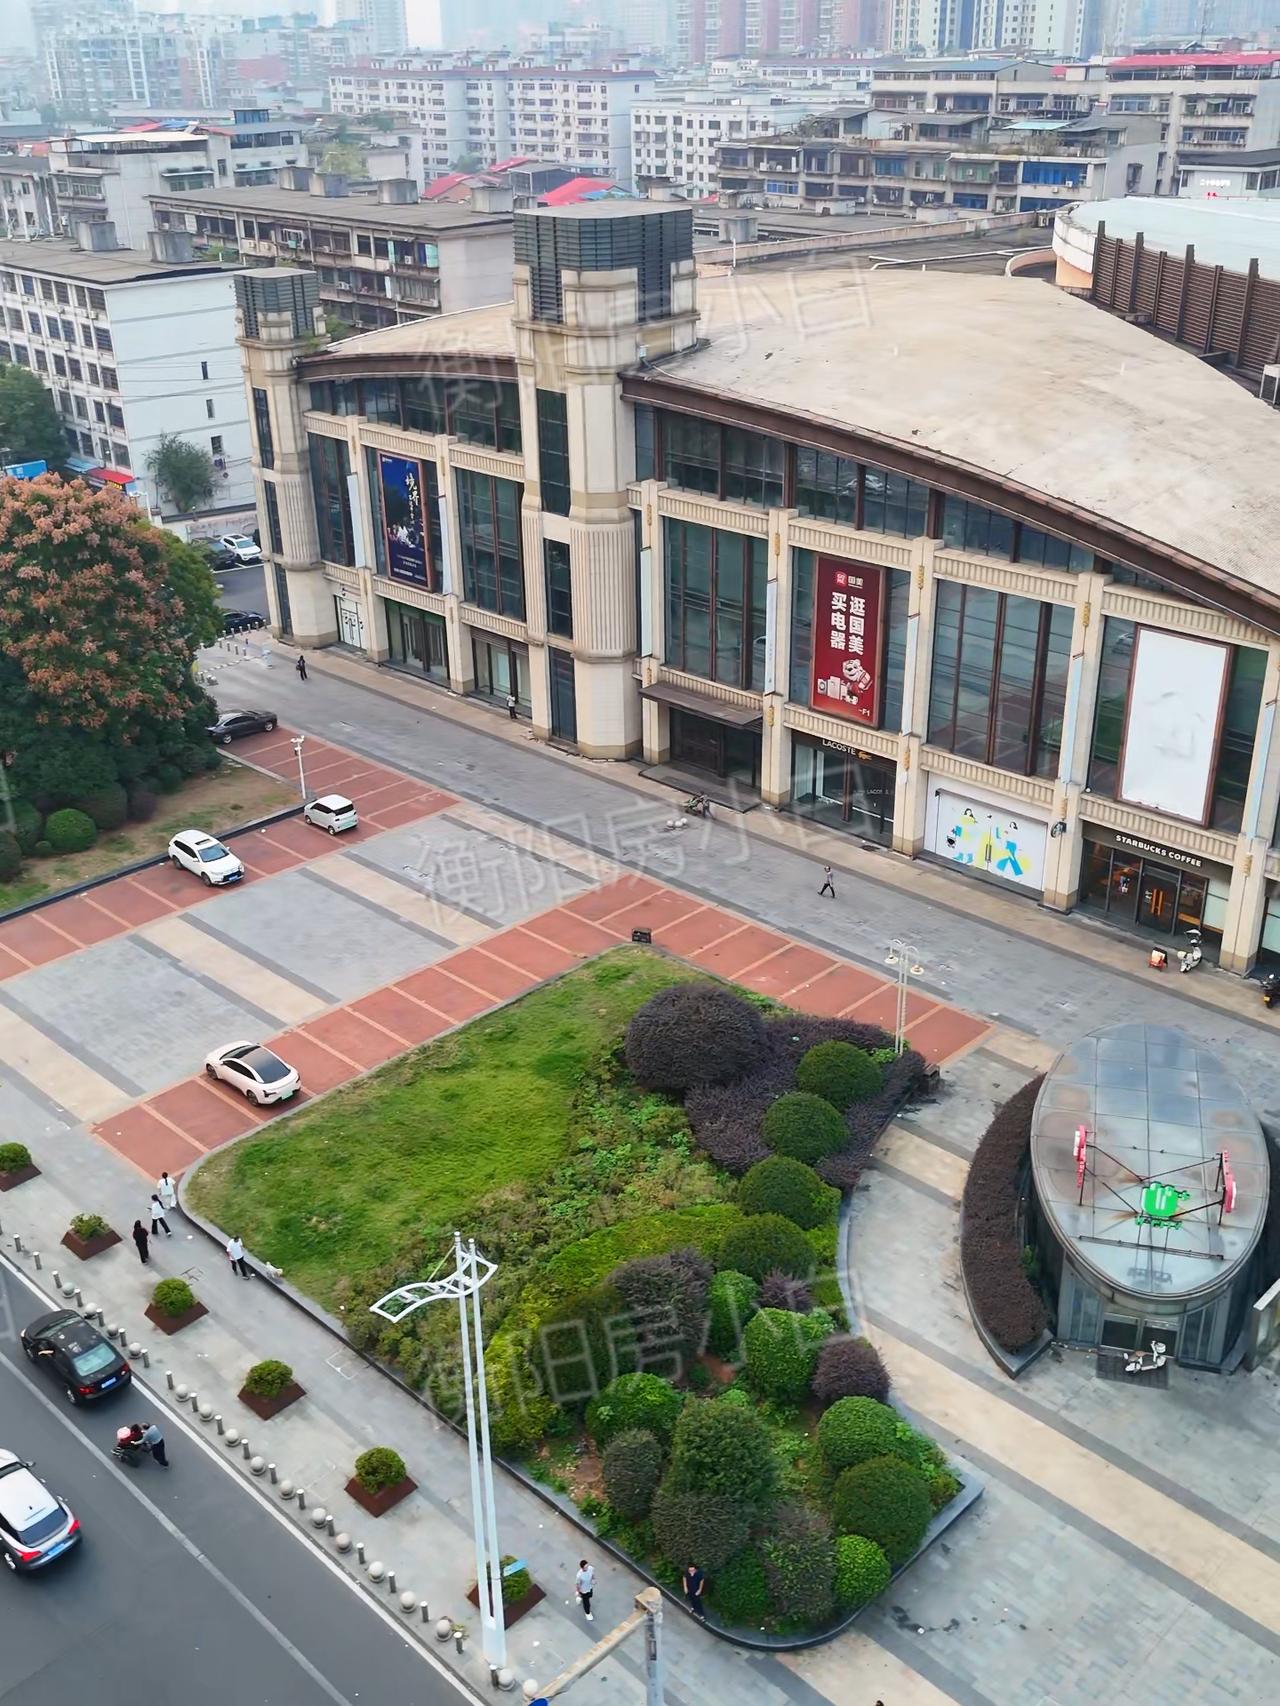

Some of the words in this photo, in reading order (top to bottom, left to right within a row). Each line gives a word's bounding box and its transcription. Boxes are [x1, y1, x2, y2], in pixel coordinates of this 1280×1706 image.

[848, 575, 864, 586] 国美
[830, 591, 848, 651] 买电器
[848, 596, 866, 656] 逛国美
[821, 738, 857, 756] LACOSTE
[1115, 834, 1167, 857] STARBUCKS
[1168, 851, 1202, 867] COFFEE
